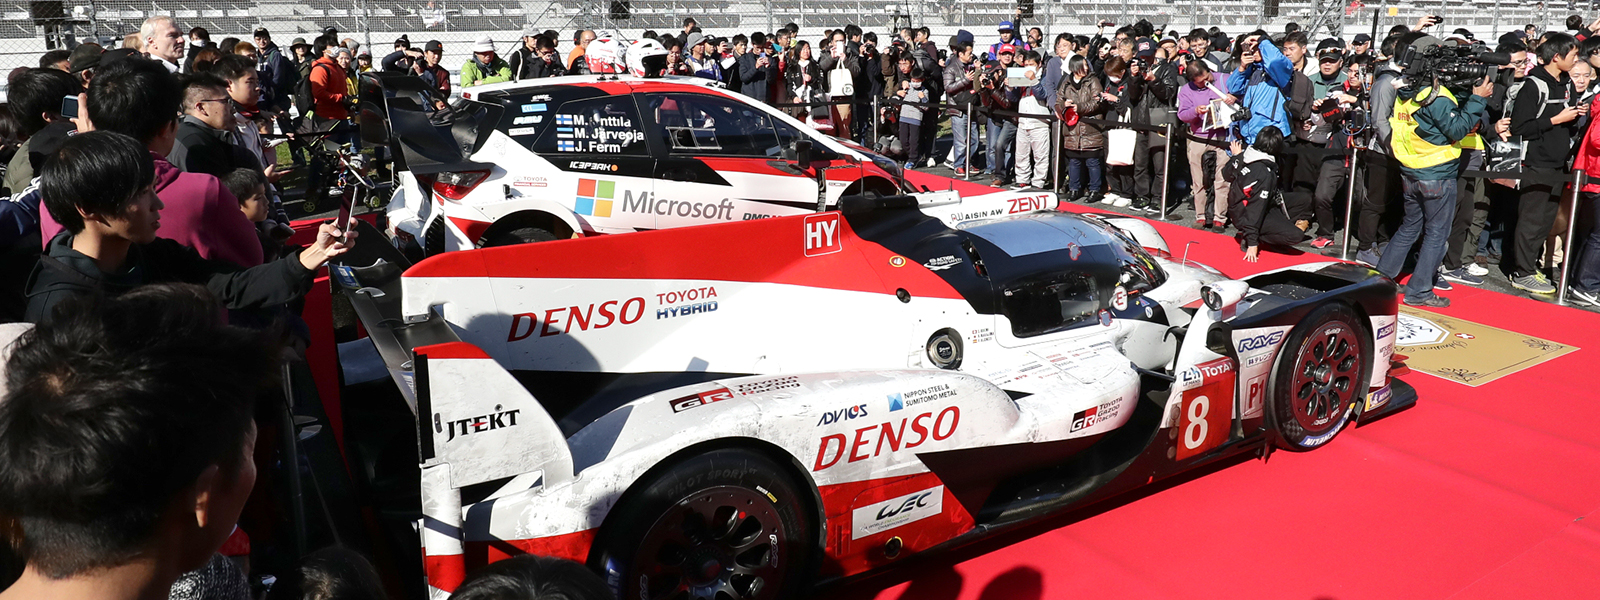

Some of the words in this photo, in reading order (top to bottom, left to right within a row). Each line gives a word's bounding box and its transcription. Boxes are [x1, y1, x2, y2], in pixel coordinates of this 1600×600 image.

[573, 114, 589, 126] M.
[574, 127, 589, 139] M.
[575, 141, 587, 152] J.
[588, 141, 621, 153] Ferm
[622, 189, 735, 220] Microsoft
[965, 211, 988, 220] AISIN
[990, 208, 1004, 216] AW
[1007, 195, 1049, 214] ZENT
[806, 219, 838, 250] HY
[656, 286, 718, 305] TOYOTA
[507, 297, 646, 342] DENSO
[656, 301, 718, 320] HYBRID
[1238, 330, 1284, 353] RAYS
[904, 389, 927, 399] NIPPON
[927, 384, 945, 394] STEEL
[905, 393, 939, 407] SUMITOMO
[938, 389, 957, 399] METAL
[1248, 379, 1265, 409] P1
[673, 391, 732, 413] GR
[1097, 404, 1120, 417] GAZOO
[1099, 396, 1123, 410] TOYOTA
[816, 404, 868, 427] ADVICS
[1071, 414, 1096, 431] GR
[1096, 411, 1119, 424] Racing
[1184, 395, 1210, 449] 8
[446, 409, 521, 443] JTEKT
[812, 405, 960, 472] DENSO
[707, 469, 745, 480] SPORT
[876, 491, 932, 520] WEC
